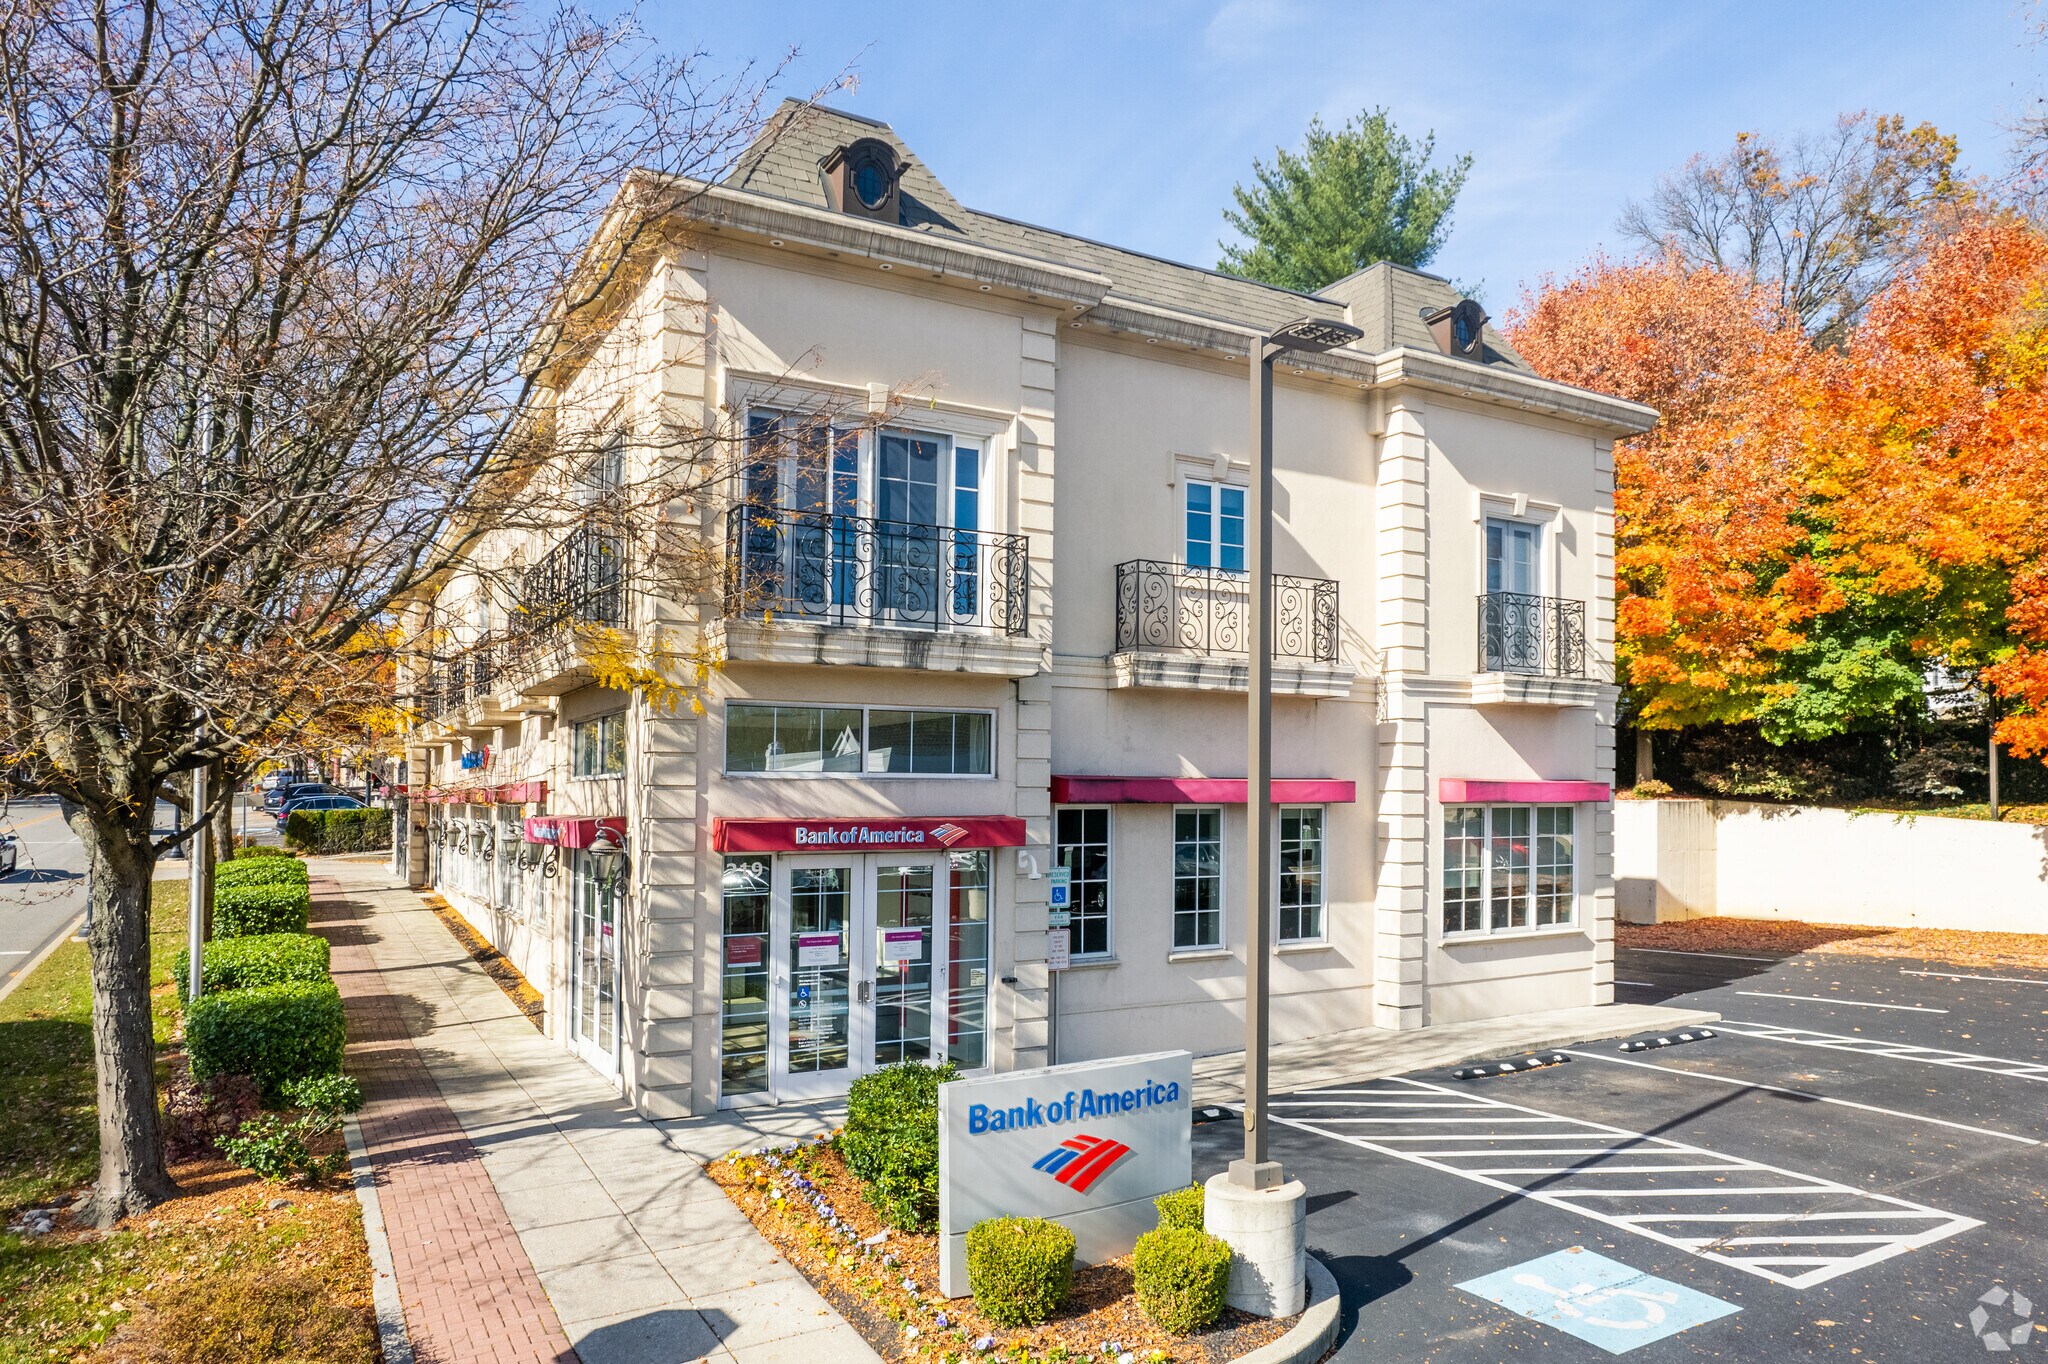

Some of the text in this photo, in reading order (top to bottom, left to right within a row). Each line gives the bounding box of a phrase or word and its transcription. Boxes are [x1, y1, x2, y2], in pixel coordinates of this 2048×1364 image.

[796, 826, 924, 844] Bank of America
[968, 1079, 1179, 1135] Bank of America
